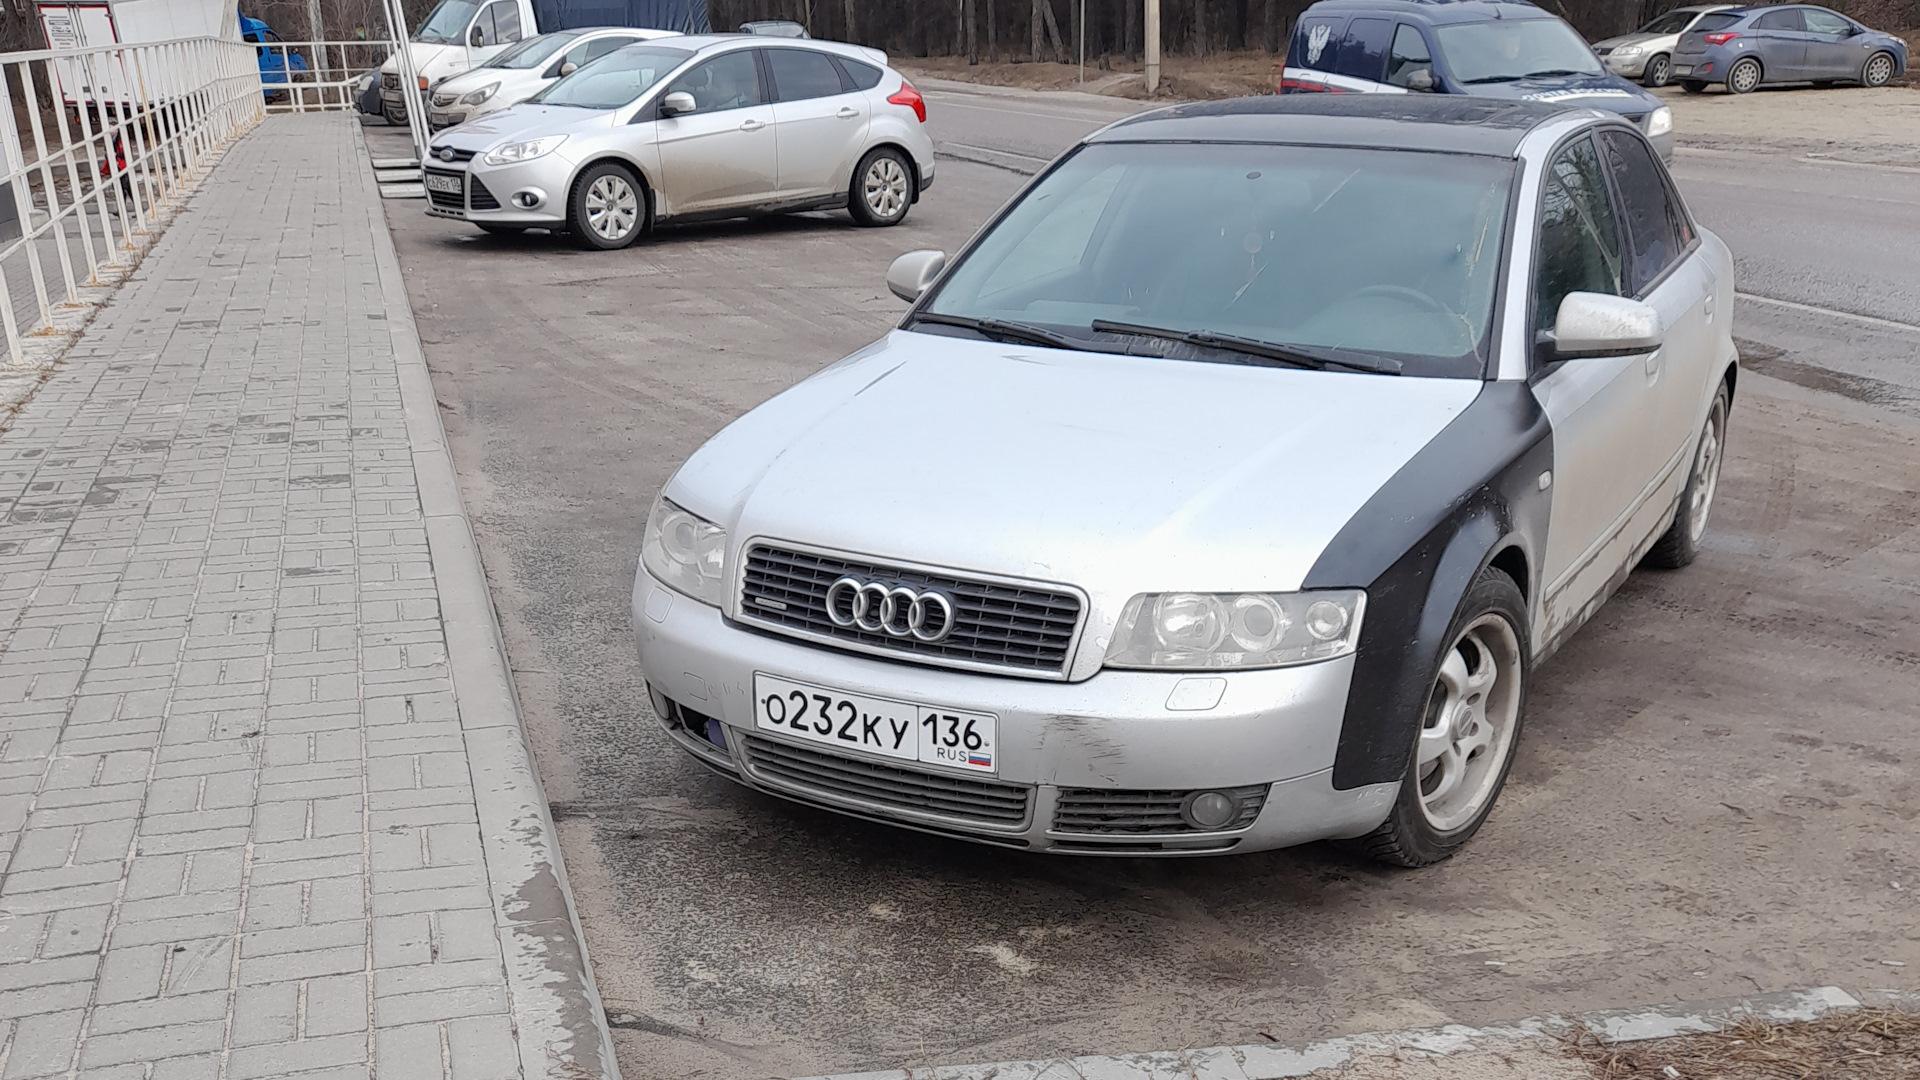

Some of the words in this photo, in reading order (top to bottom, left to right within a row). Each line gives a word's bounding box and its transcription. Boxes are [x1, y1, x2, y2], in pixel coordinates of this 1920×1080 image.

[766, 690, 909, 750] О232КУ
[922, 713, 983, 750] 136
[937, 747, 967, 762] RUS
